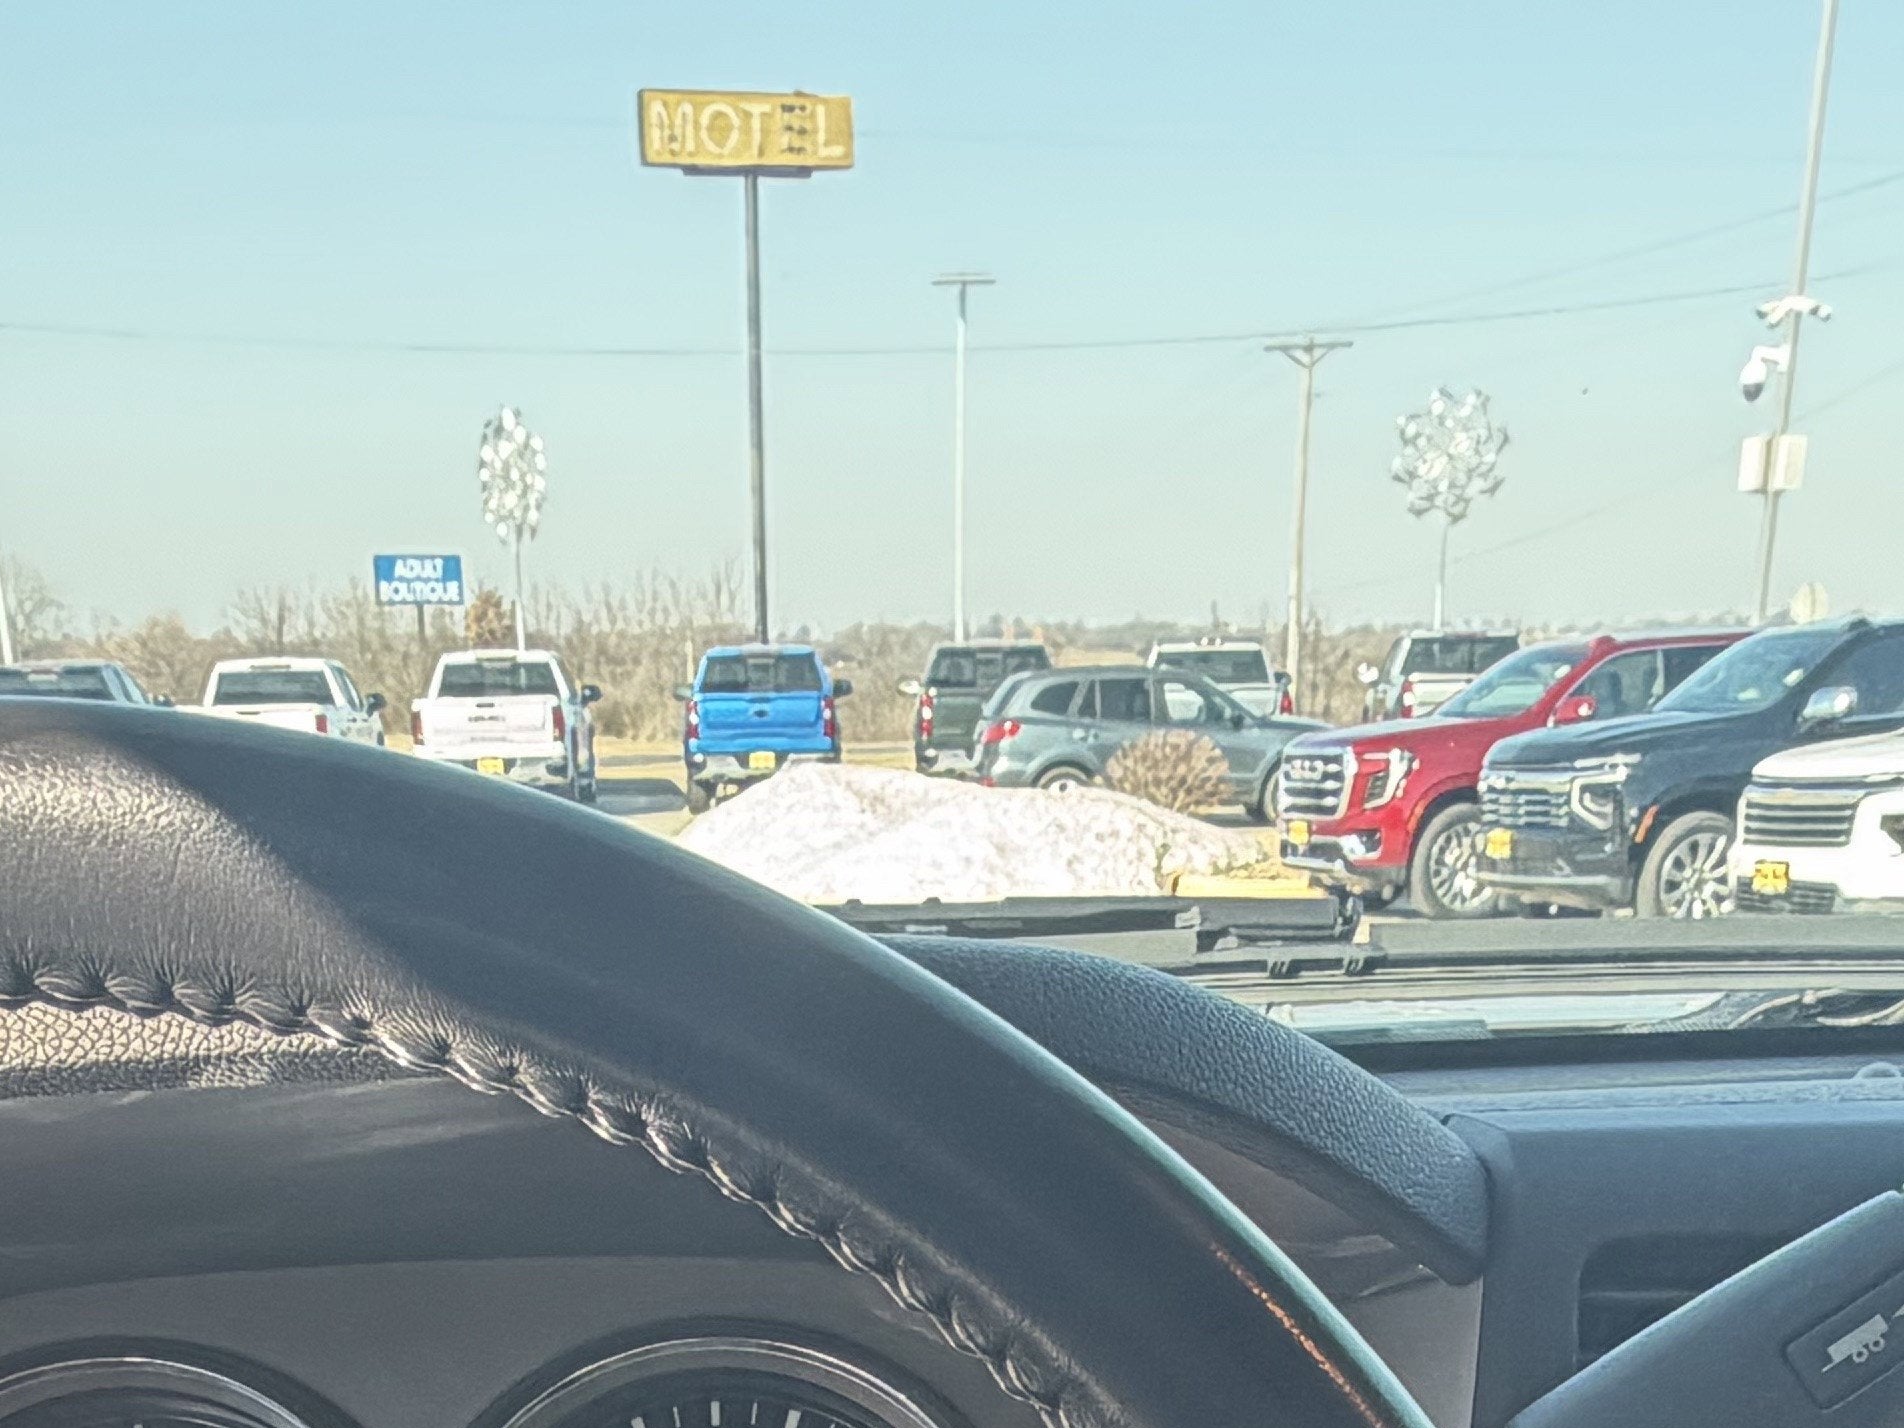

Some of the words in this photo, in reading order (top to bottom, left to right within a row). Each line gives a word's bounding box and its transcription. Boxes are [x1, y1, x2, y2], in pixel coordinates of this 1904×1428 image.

[650, 100, 847, 158] MOTEL
[394, 558, 444, 579] ADULT
[379, 580, 460, 602] BOUTIQUE
